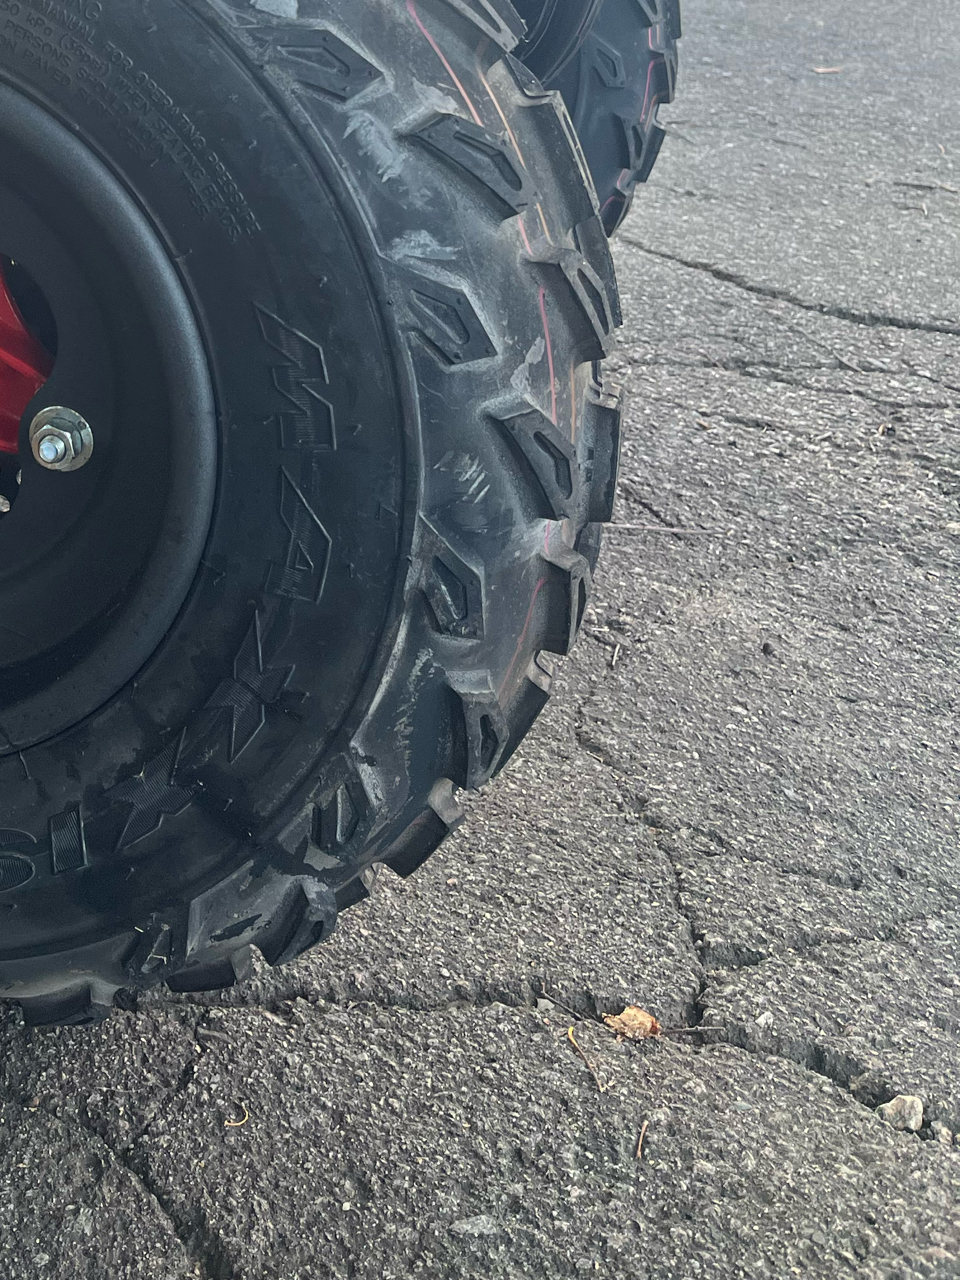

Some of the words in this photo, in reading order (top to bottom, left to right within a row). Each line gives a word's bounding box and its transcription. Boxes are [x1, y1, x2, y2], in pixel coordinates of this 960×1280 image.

[3, 19, 73, 69] PERSONS
[100, 40, 135, 73] FOR
[133, 69, 207, 151] OPERATING
[112, 75, 153, 116] WHEN
[152, 116, 206, 181] SEATING
